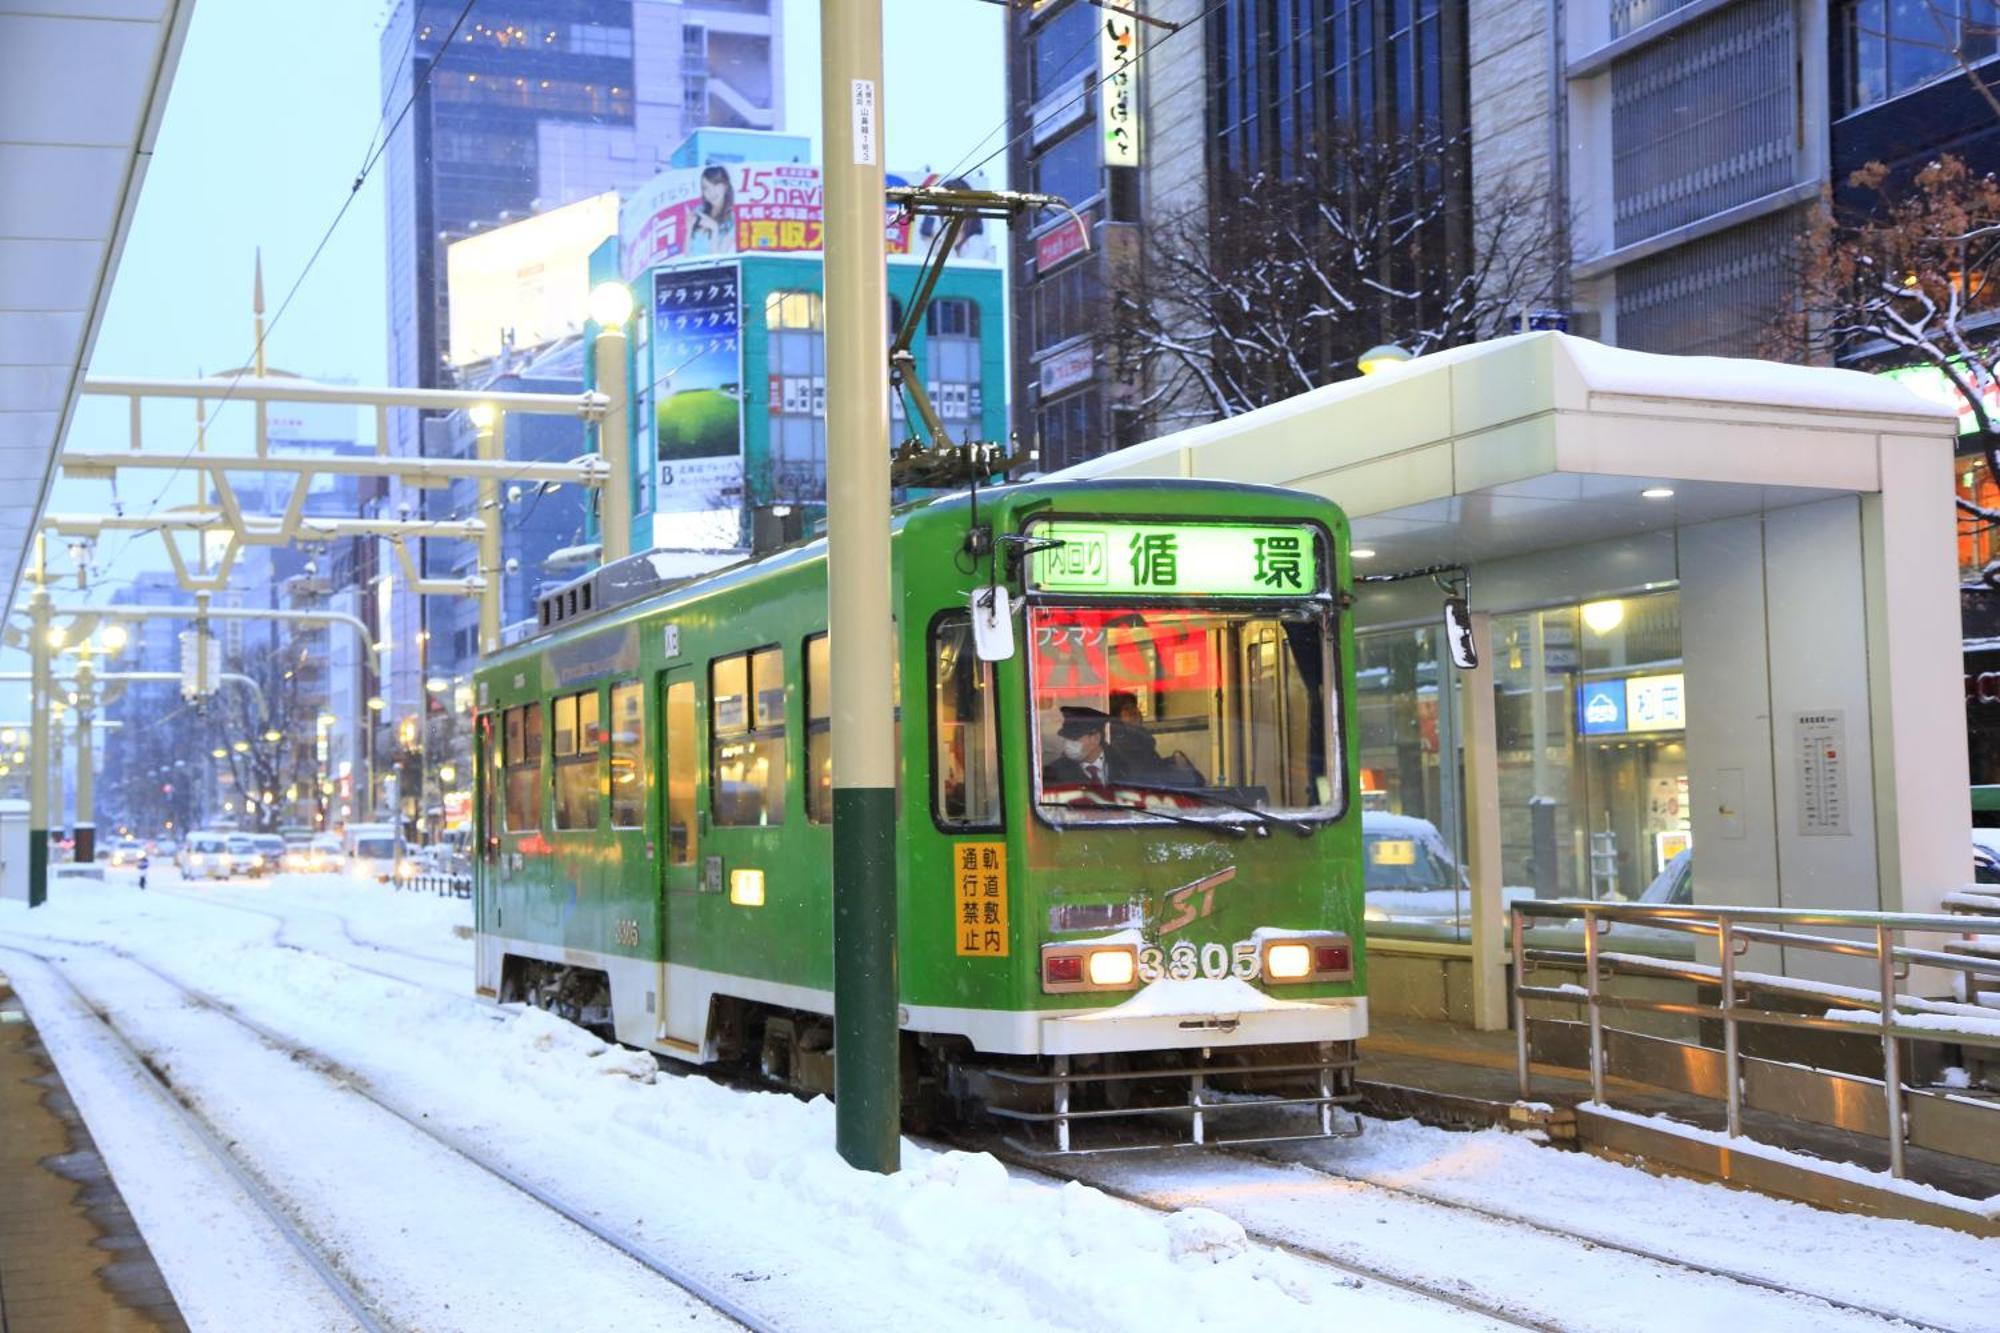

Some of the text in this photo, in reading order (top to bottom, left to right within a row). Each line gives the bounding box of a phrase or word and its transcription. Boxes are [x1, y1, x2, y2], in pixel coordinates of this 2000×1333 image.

[739, 167, 772, 204] 15
[657, 284, 737, 305] デラックス
[657, 311, 737, 332] リラックス
[661, 466, 674, 485] B
[962, 847, 980, 951] 通行禁止
[983, 847, 1001, 953] 軌道敷内
